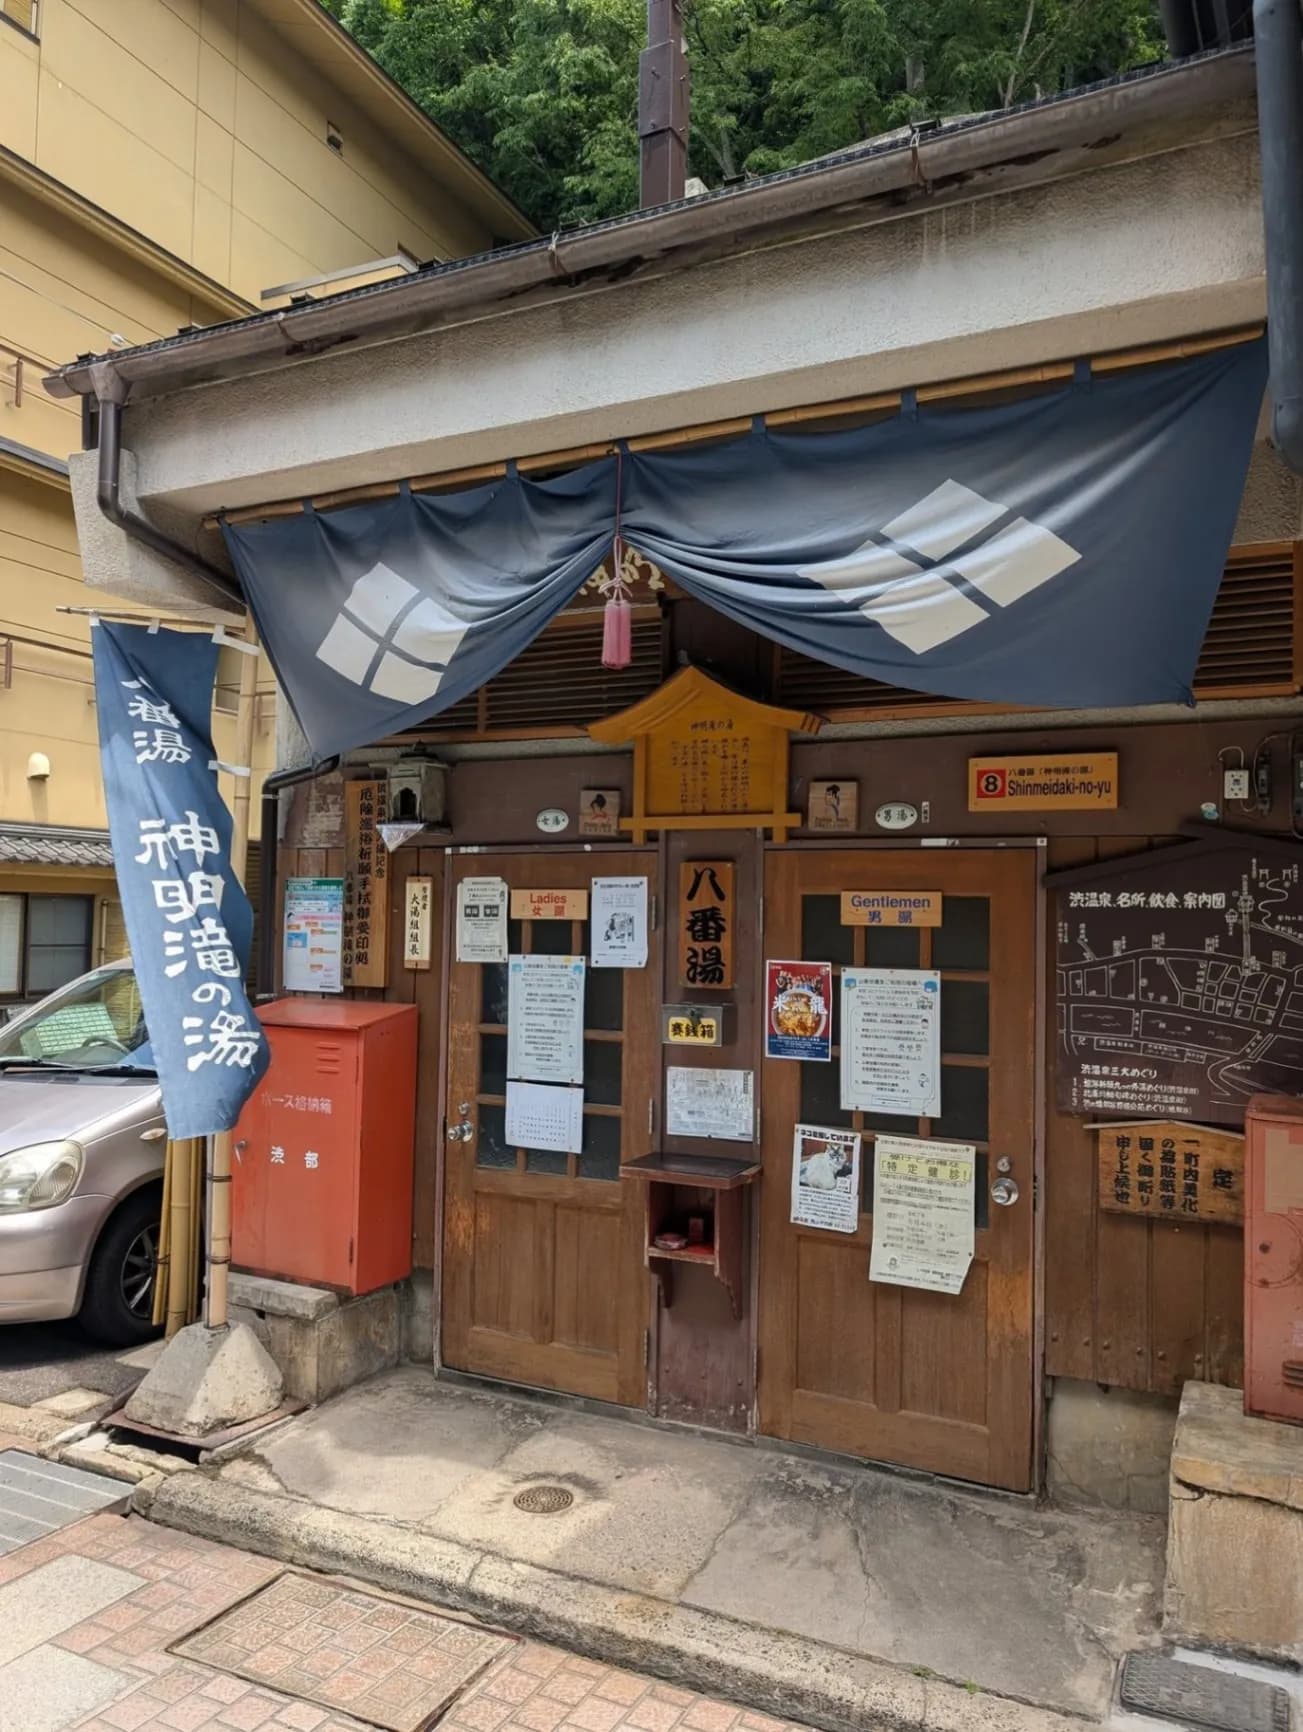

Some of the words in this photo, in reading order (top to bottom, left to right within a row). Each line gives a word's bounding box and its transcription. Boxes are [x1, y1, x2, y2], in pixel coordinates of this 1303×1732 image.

[984, 774, 999, 793] 8
[1008, 778, 1111, 798] Shinmeidaki-no-yu
[529, 892, 567, 904] Ladies
[851, 894, 930, 908] Gentlemen
[686, 867, 728, 985] 八番湯
[135, 811, 260, 1072] 神明滝の湯
[671, 1022, 714, 1039] 賽銭箱
